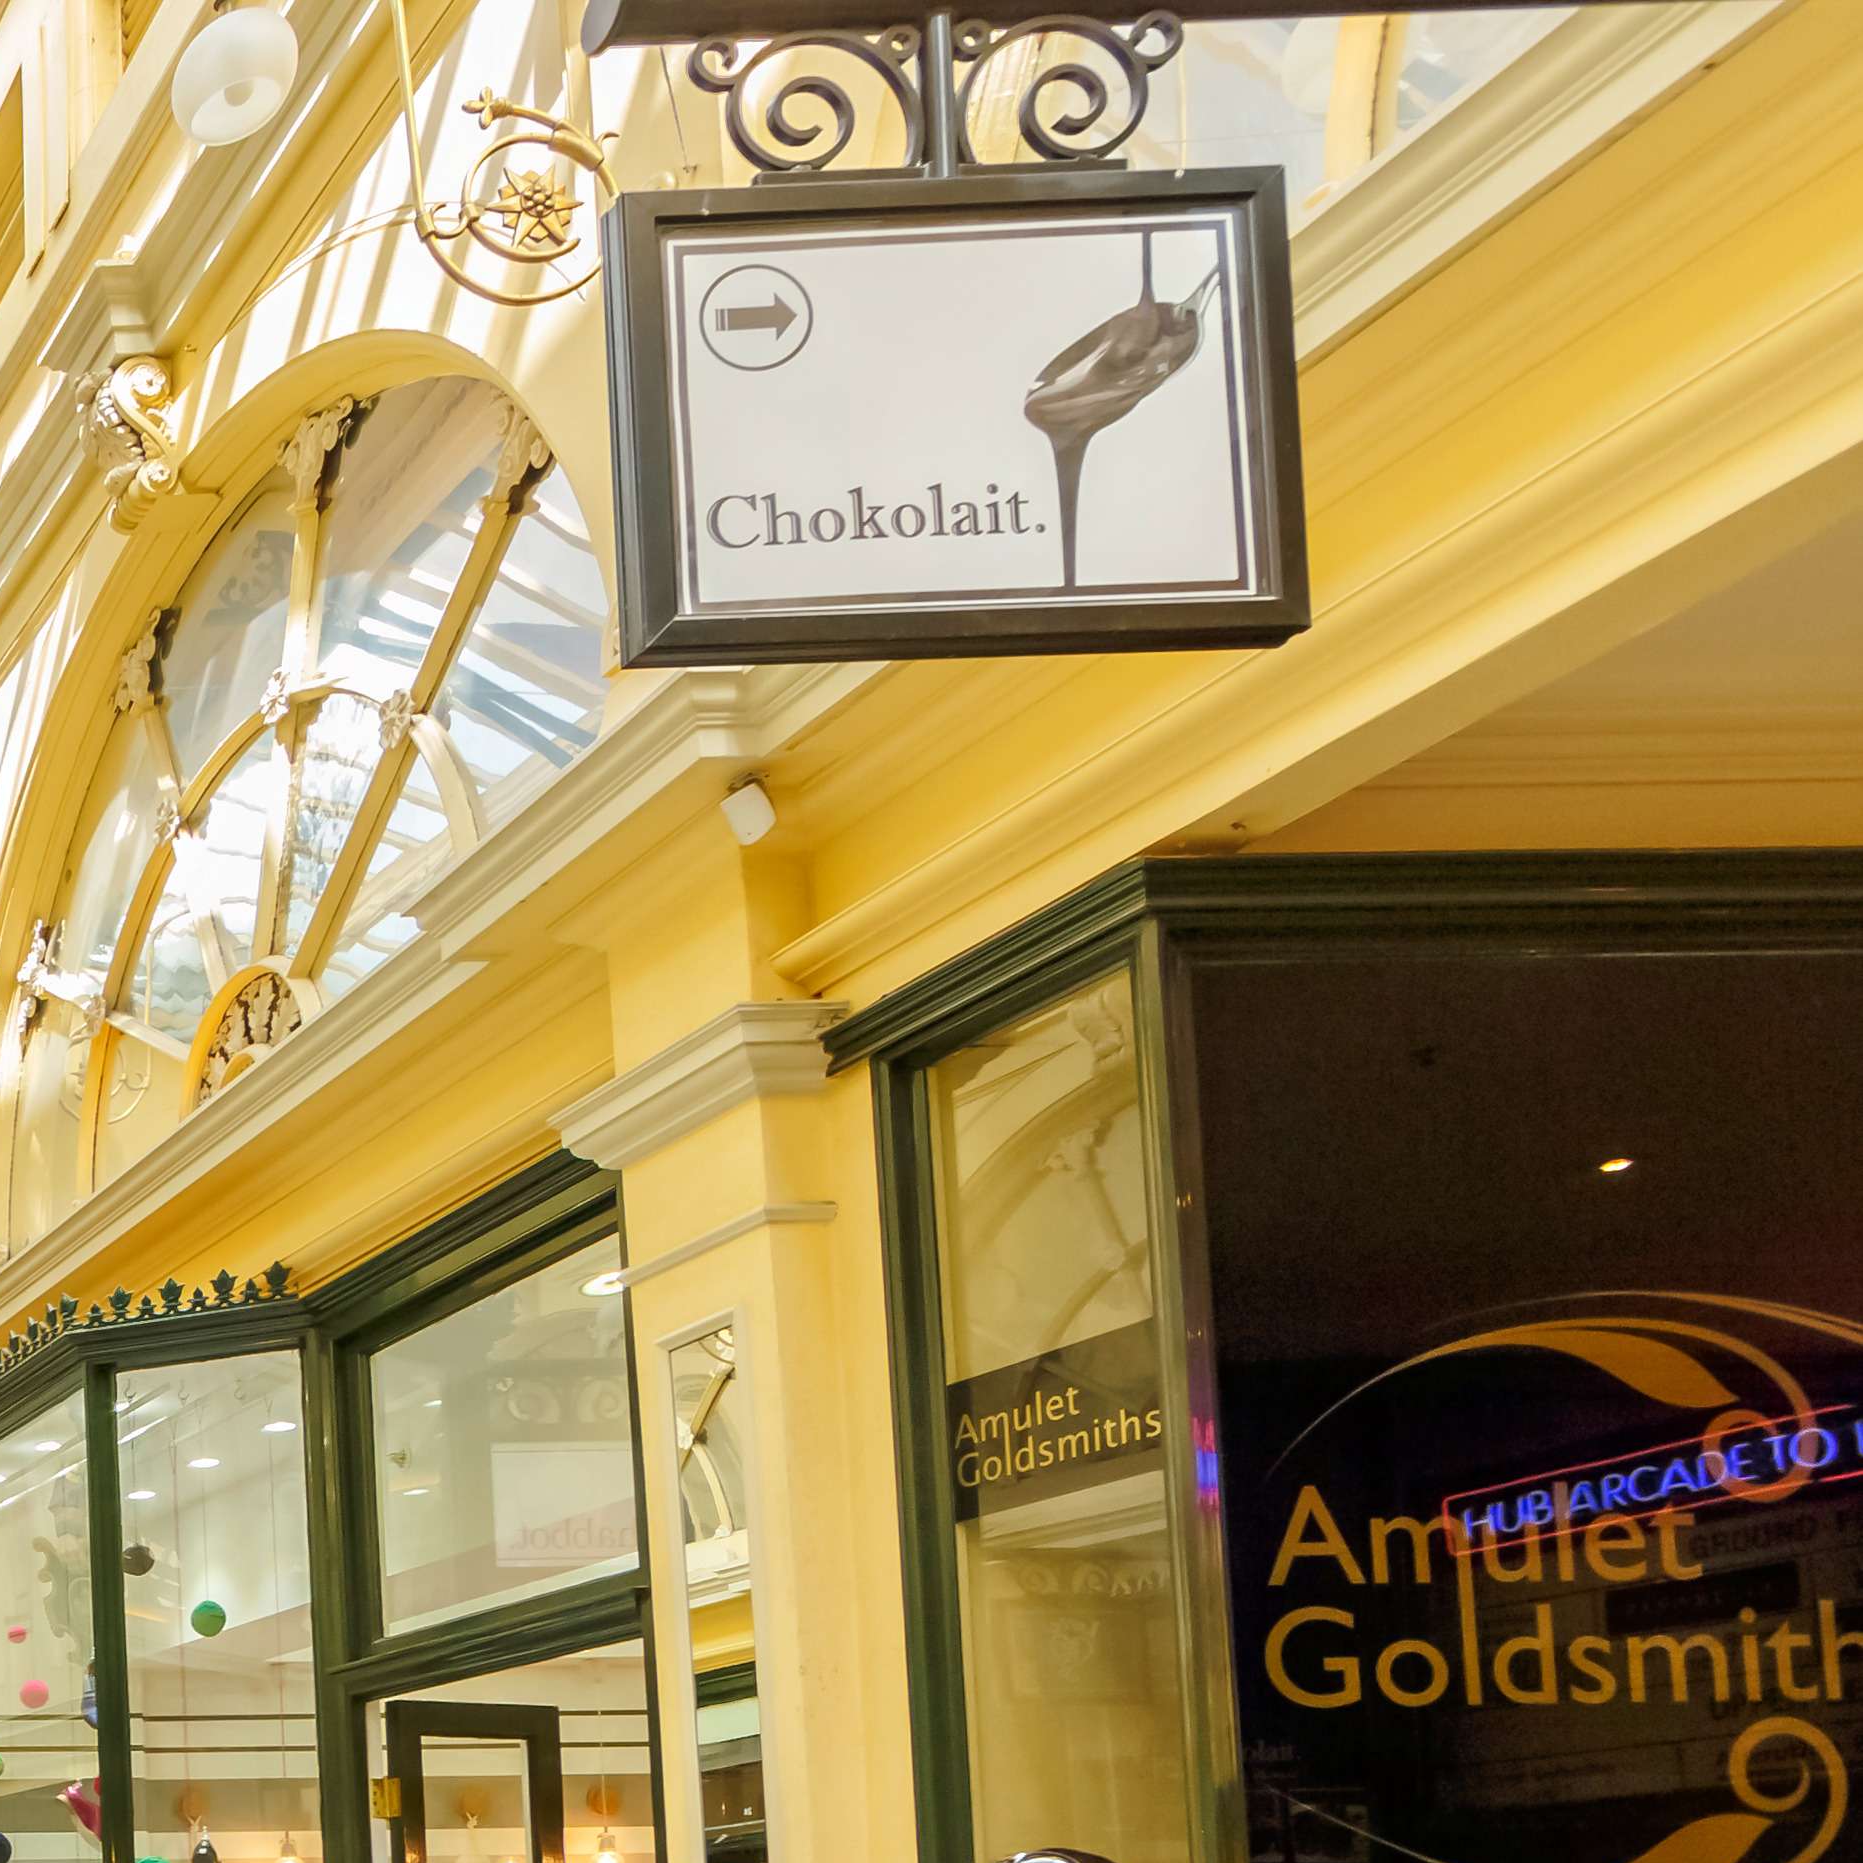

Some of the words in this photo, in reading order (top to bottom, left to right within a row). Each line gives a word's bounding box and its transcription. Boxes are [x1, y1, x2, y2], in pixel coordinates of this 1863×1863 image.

[706, 484, 1047, 550] Chokolait.
[955, 1386, 1081, 1449] Amulet
[956, 1408, 1162, 1488] Goldsmiths
[1462, 1490, 1554, 1542] HUB
[1568, 1443, 1760, 1518] ARCADE
[1764, 1426, 1839, 1472] TO
[1268, 1484, 1703, 1586] Amulet
